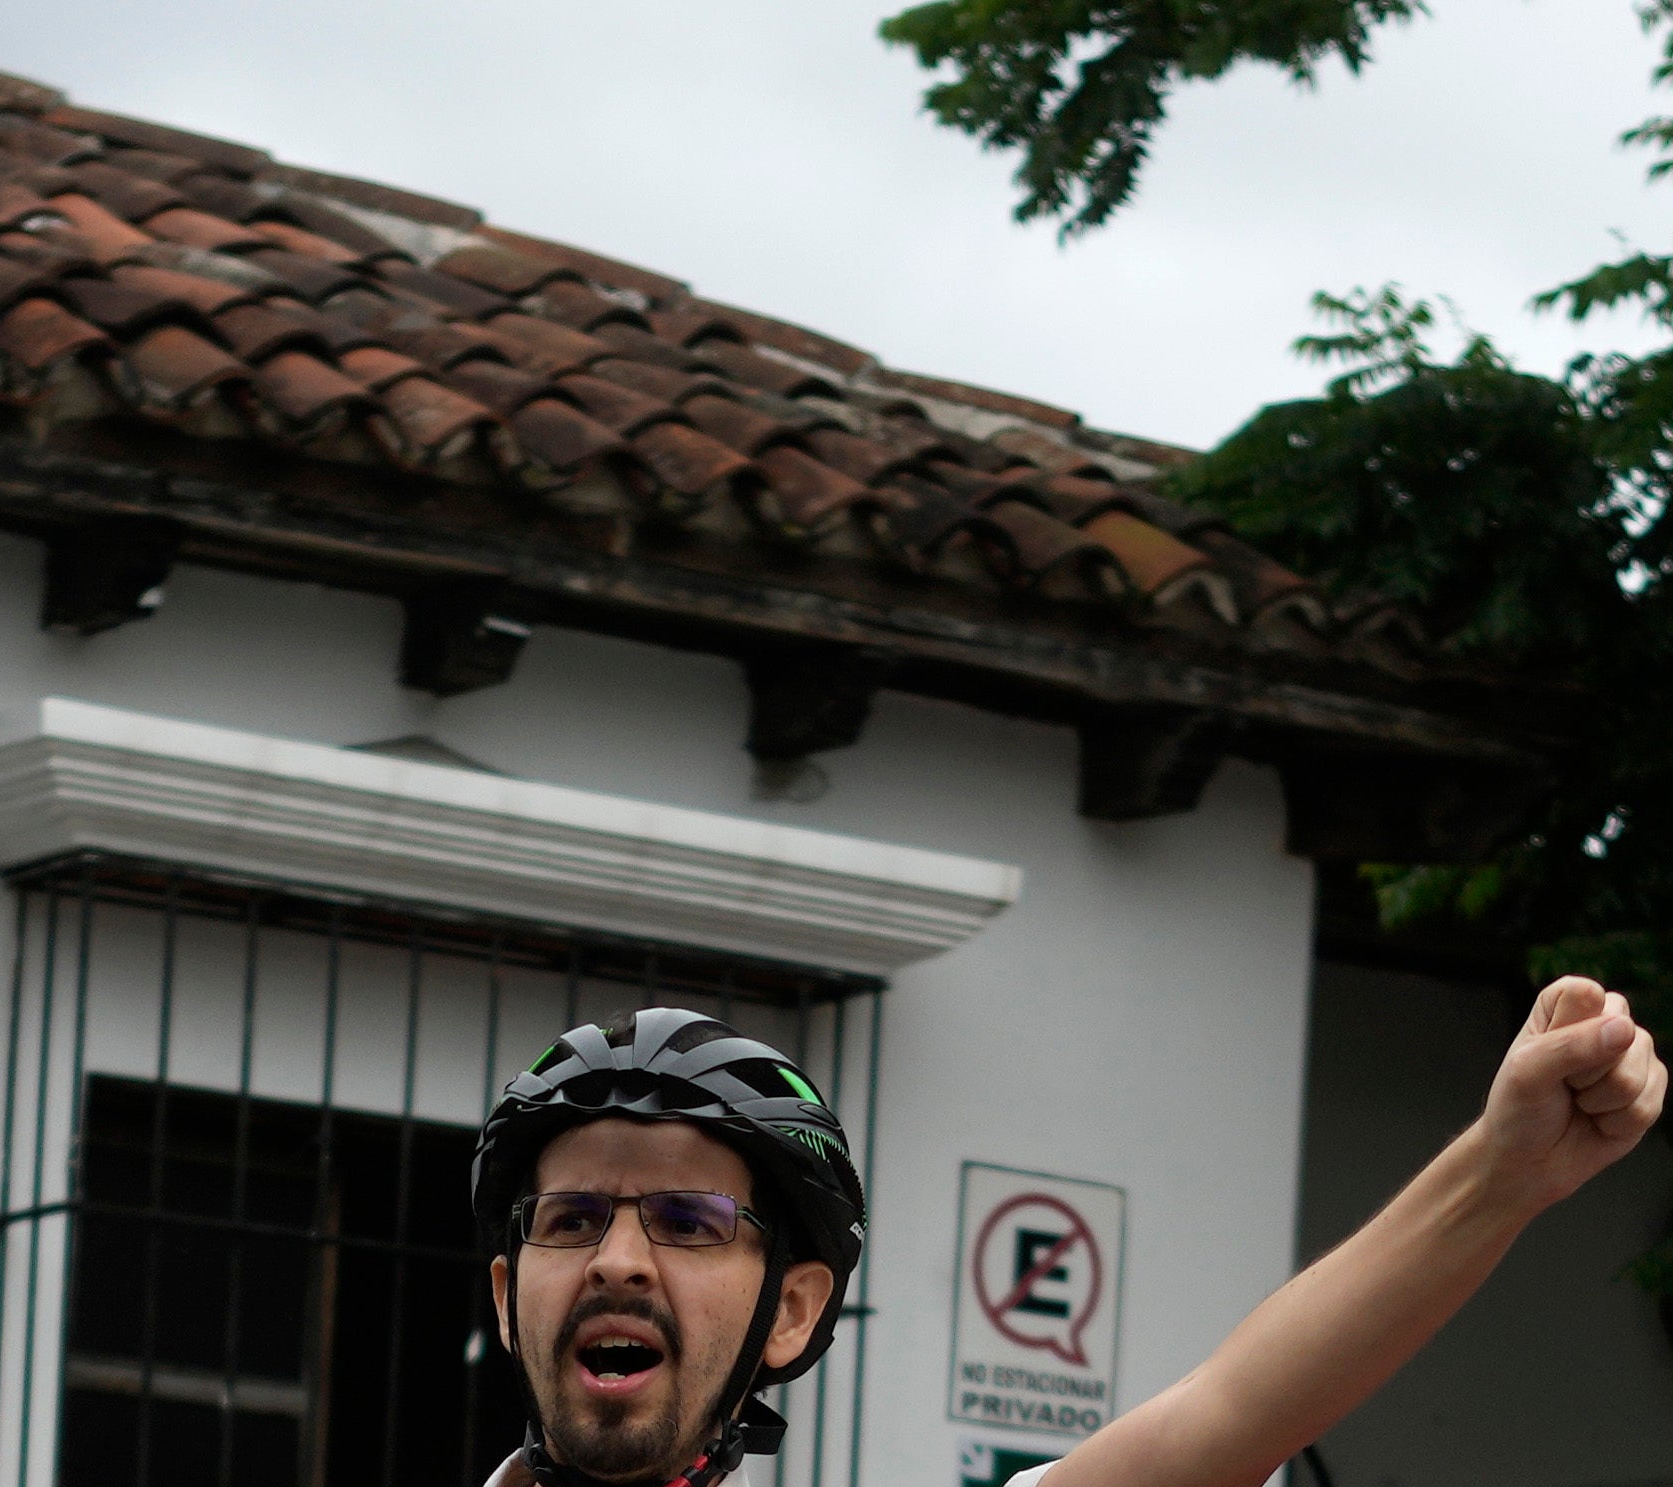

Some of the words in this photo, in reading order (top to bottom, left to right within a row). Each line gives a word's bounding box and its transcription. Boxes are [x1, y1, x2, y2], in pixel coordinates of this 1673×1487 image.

[961, 1363, 987, 1385] NO
[993, 1365, 1106, 1398] ESTACIONAR
[961, 1391, 1102, 1431] PRIVADO
